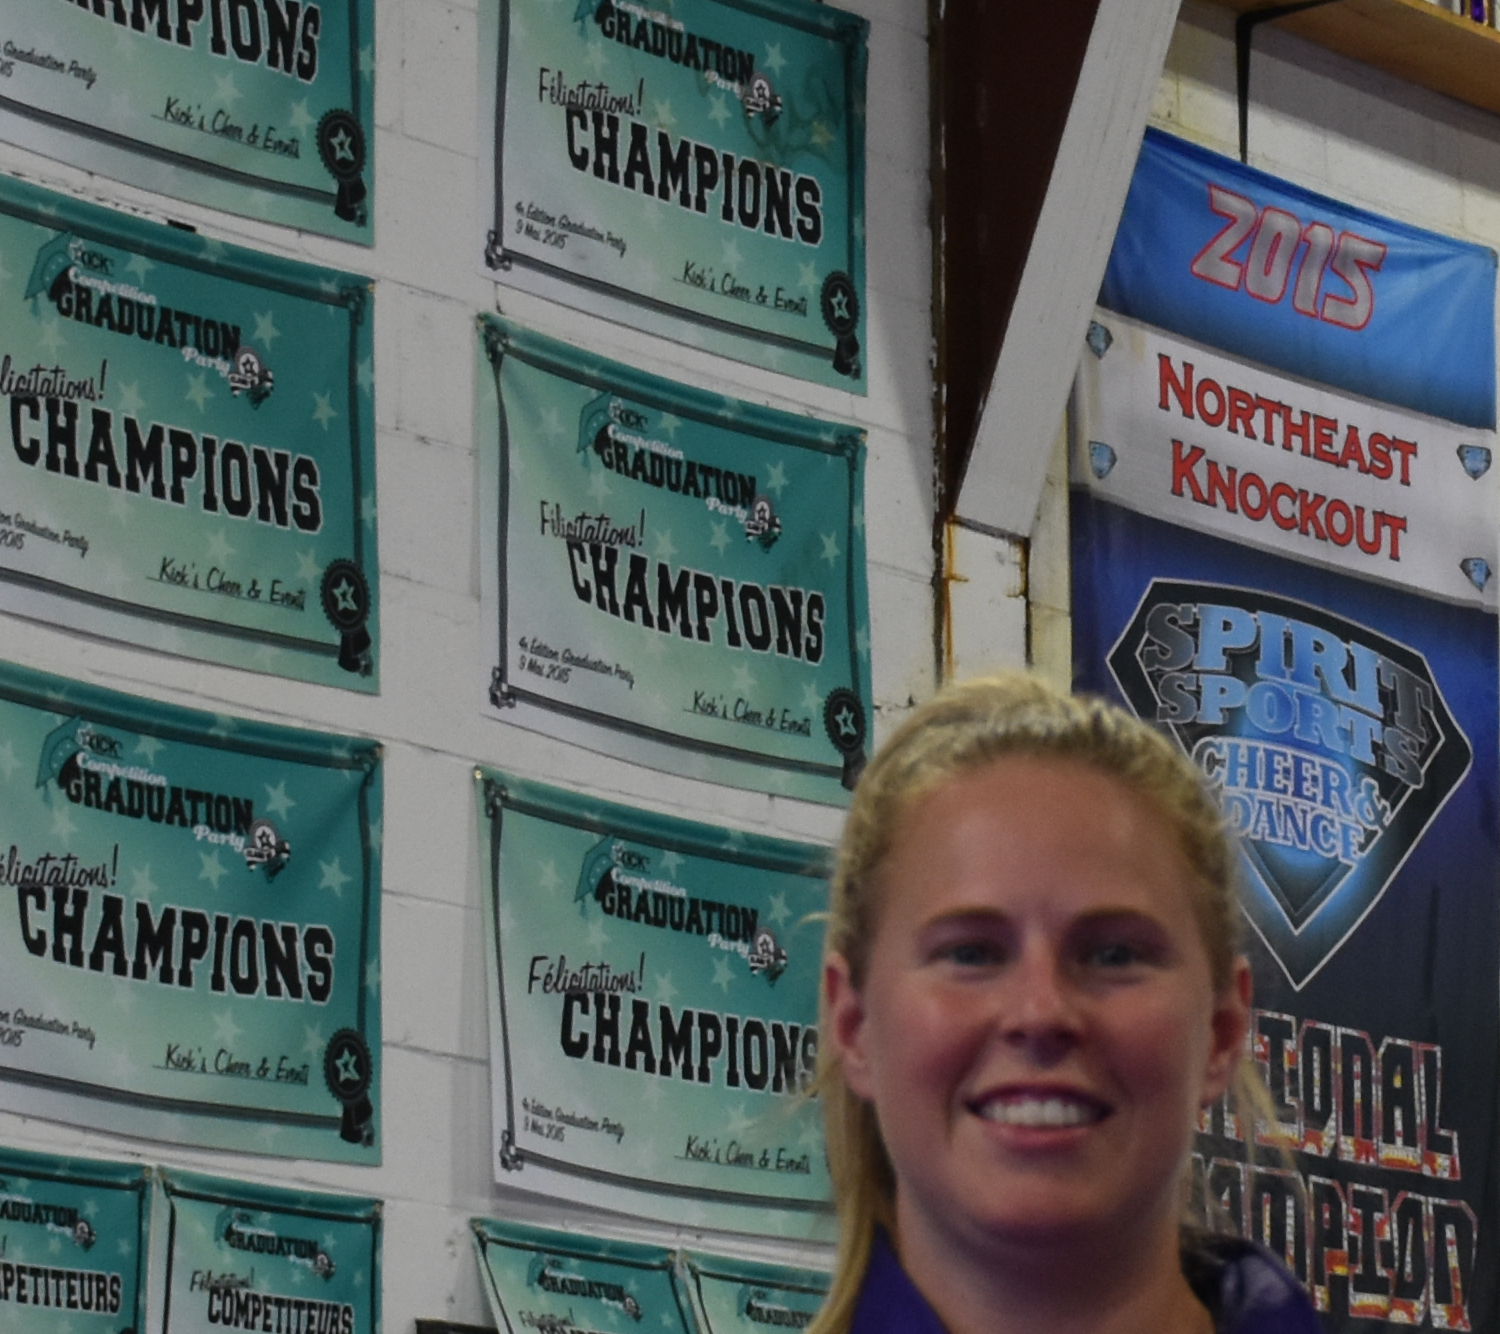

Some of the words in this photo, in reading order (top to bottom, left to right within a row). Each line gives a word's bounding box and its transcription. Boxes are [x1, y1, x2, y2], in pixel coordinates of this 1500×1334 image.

[600, 5, 756, 84] GRADUATION
[564, 109, 824, 246] CHAMPIONS
[1190, 183, 1387, 331] 2015
[55, 280, 241, 354] GRADUATION
[9, 394, 322, 533] CHAMPIONS
[600, 440, 757, 508] GRADUATION
[1158, 354, 1418, 486] NORTHEAST
[1171, 439, 1407, 562] KNOCKOUT
[567, 540, 825, 665] CHAMPIONS
[1144, 603, 1434, 739] SPIRIT
[1158, 676, 1424, 789] SPORTS
[1194, 737, 1360, 813] CHEER
[64, 768, 254, 836] GRADUATION
[1224, 788, 1364, 866] DANCE
[16, 884, 336, 1004] CHAMPIONS
[600, 882, 759, 944] GRADUATION
[227, 1227, 319, 1259] GRADUATION
